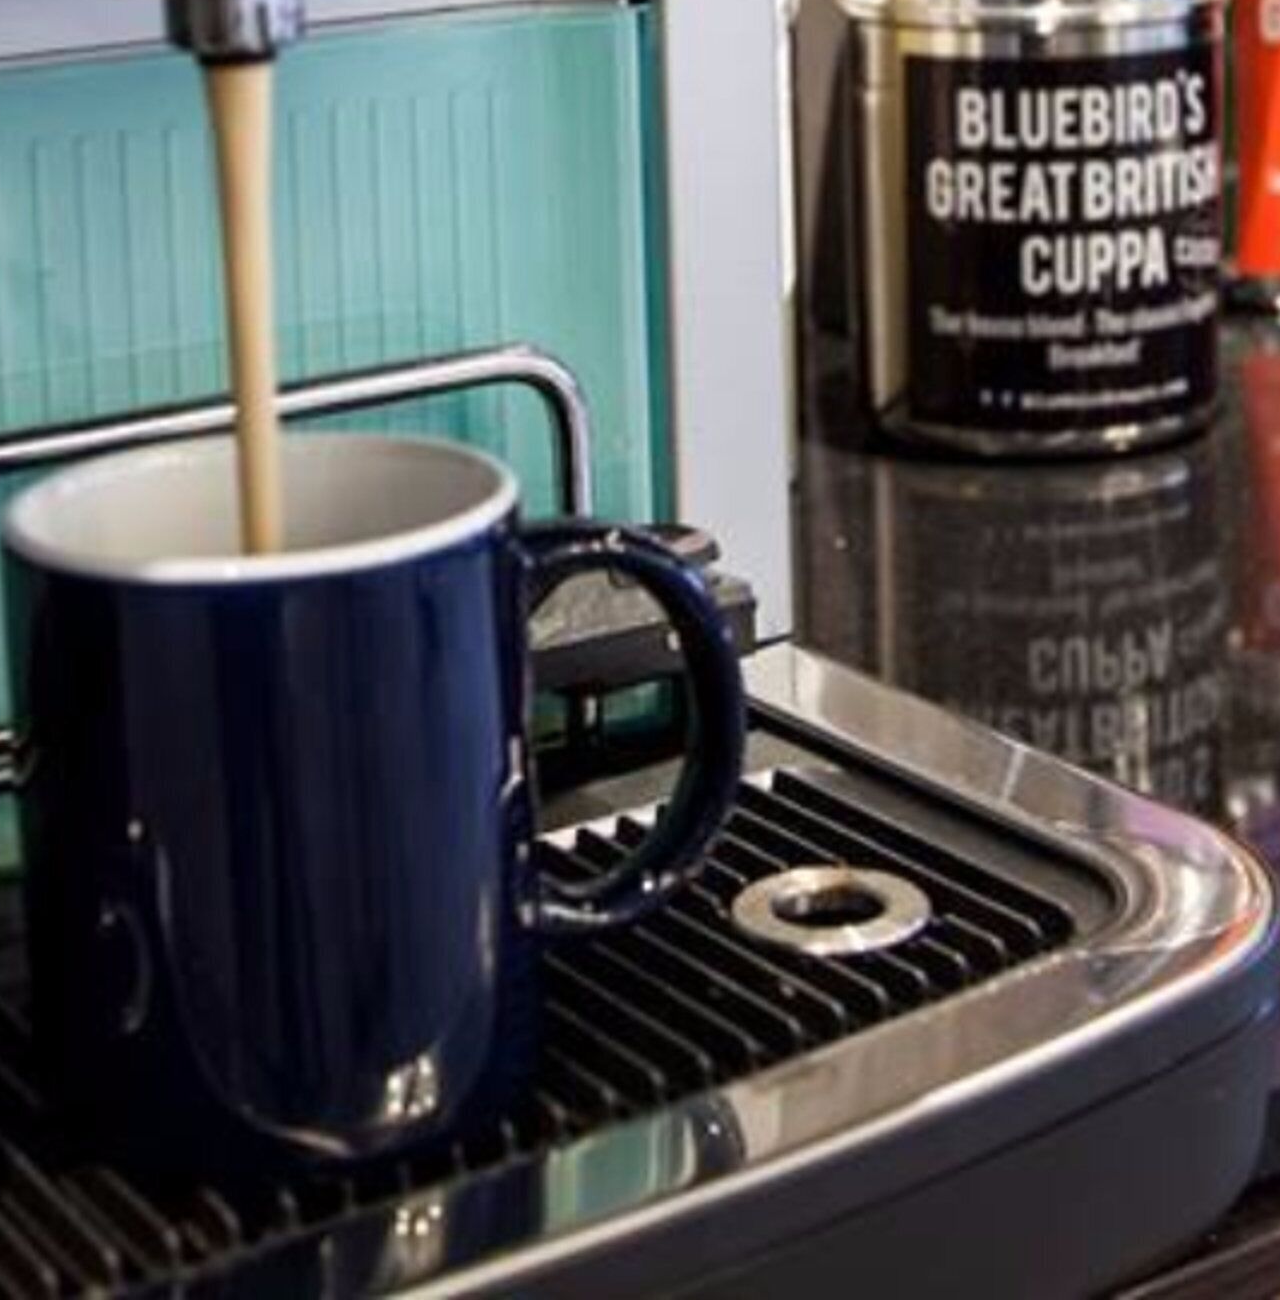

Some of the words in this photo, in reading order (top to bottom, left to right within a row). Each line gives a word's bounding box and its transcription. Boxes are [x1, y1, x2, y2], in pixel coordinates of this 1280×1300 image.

[957, 70, 1206, 150] BLUEBIRD'S
[927, 159, 1074, 221] GREAT
[1022, 226, 1168, 294] CUPPA
